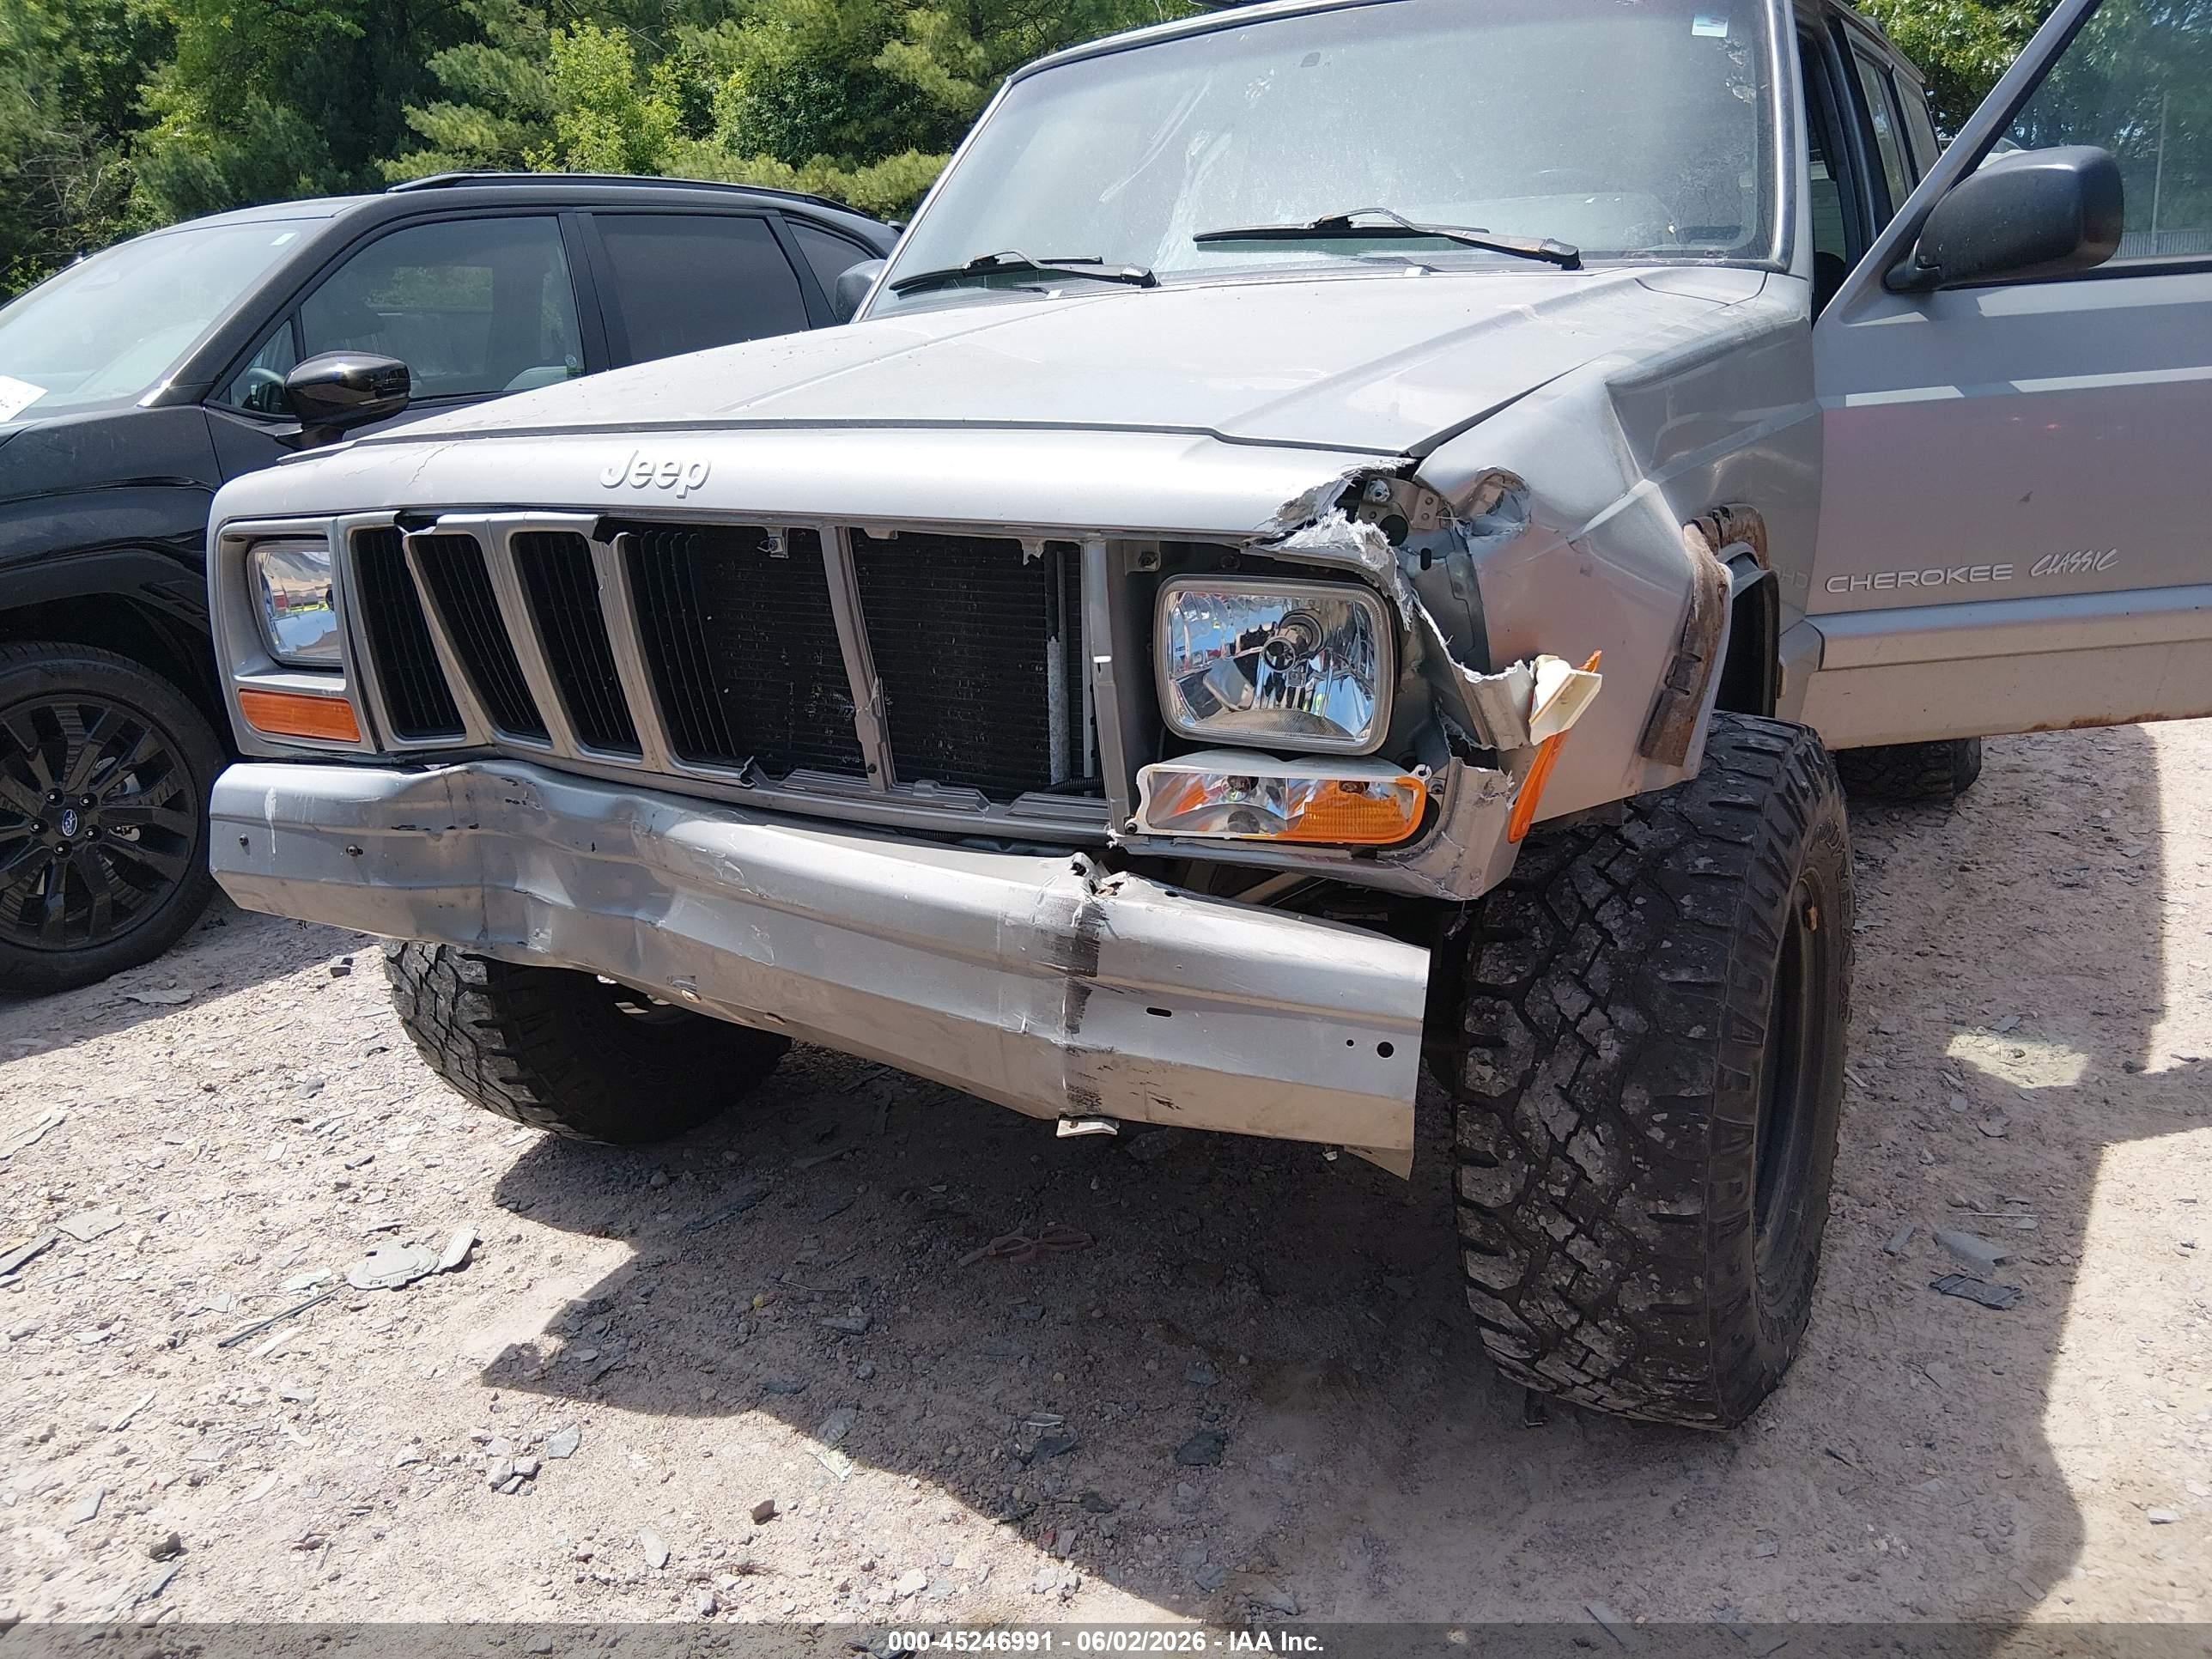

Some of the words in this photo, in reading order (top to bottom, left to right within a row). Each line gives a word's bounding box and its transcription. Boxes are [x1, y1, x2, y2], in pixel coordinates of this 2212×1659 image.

[599, 449, 712, 500] Jeep
[1825, 563, 2014, 594] CHEROKEE
[2029, 548, 2120, 578] CLASSIC
